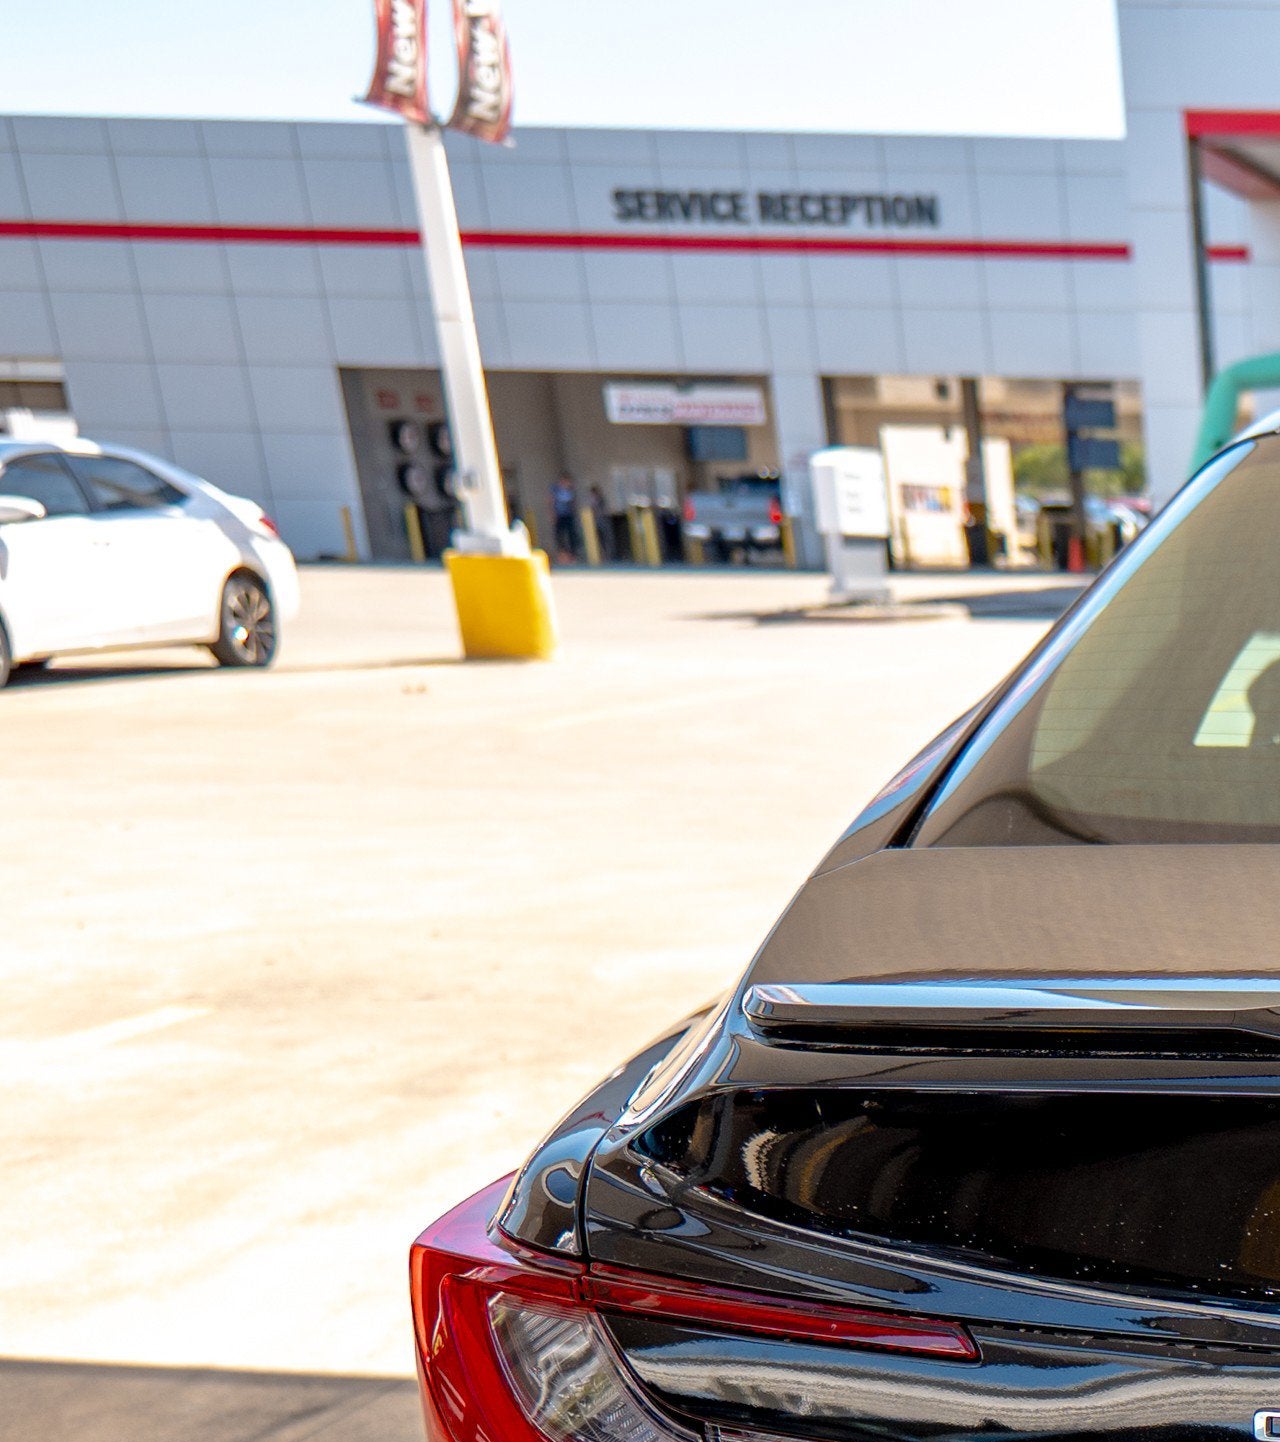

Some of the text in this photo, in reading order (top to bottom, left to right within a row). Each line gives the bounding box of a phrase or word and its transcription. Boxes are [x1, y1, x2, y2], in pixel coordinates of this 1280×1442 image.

[467, 26, 501, 123] New
[613, 189, 939, 228] SERVICE RECEPTION
